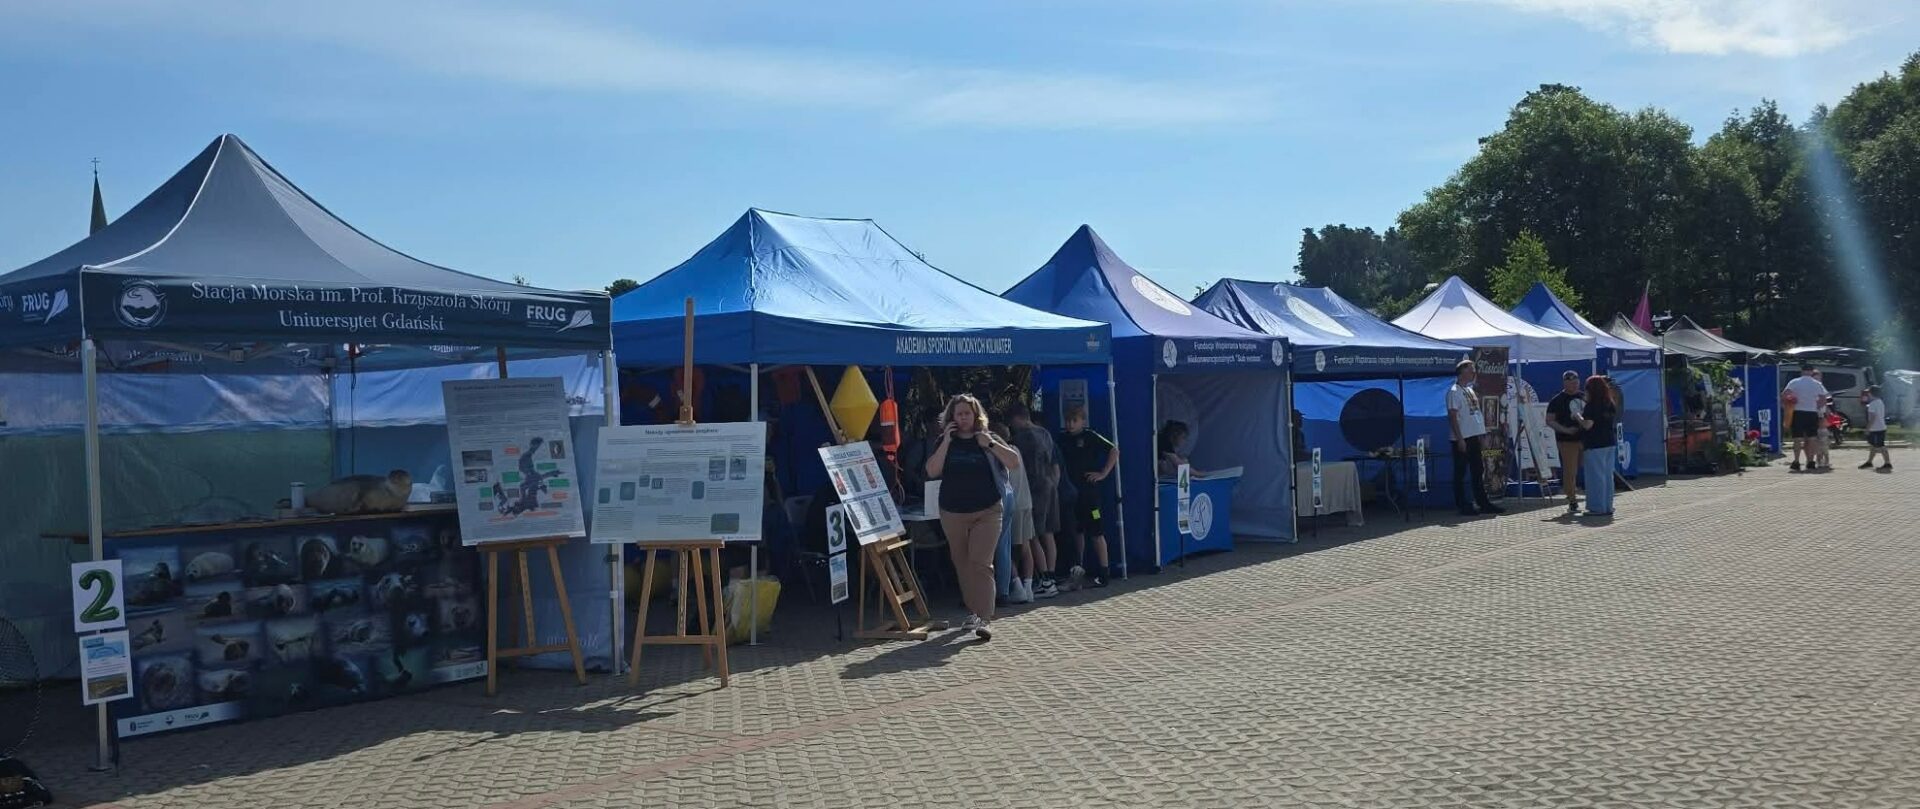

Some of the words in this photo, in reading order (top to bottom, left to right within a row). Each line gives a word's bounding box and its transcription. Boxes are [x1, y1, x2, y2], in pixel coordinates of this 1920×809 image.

[22, 291, 50, 313] FRUG
[192, 281, 246, 303] Stacja
[251, 284, 315, 301] Morska
[320, 287, 345, 302] im.
[349, 286, 387, 304] Prof.
[392, 287, 465, 310] Krzysztofa
[470, 294, 511, 315] Skóry
[279, 310, 377, 333] Uniwersytet
[382, 312, 445, 331] Gdański
[526, 304, 567, 322] FRUG
[1313, 450, 1320, 475] 5
[1179, 469, 1189, 494] 4
[829, 510, 844, 548] 3
[79, 568, 120, 624] 2
